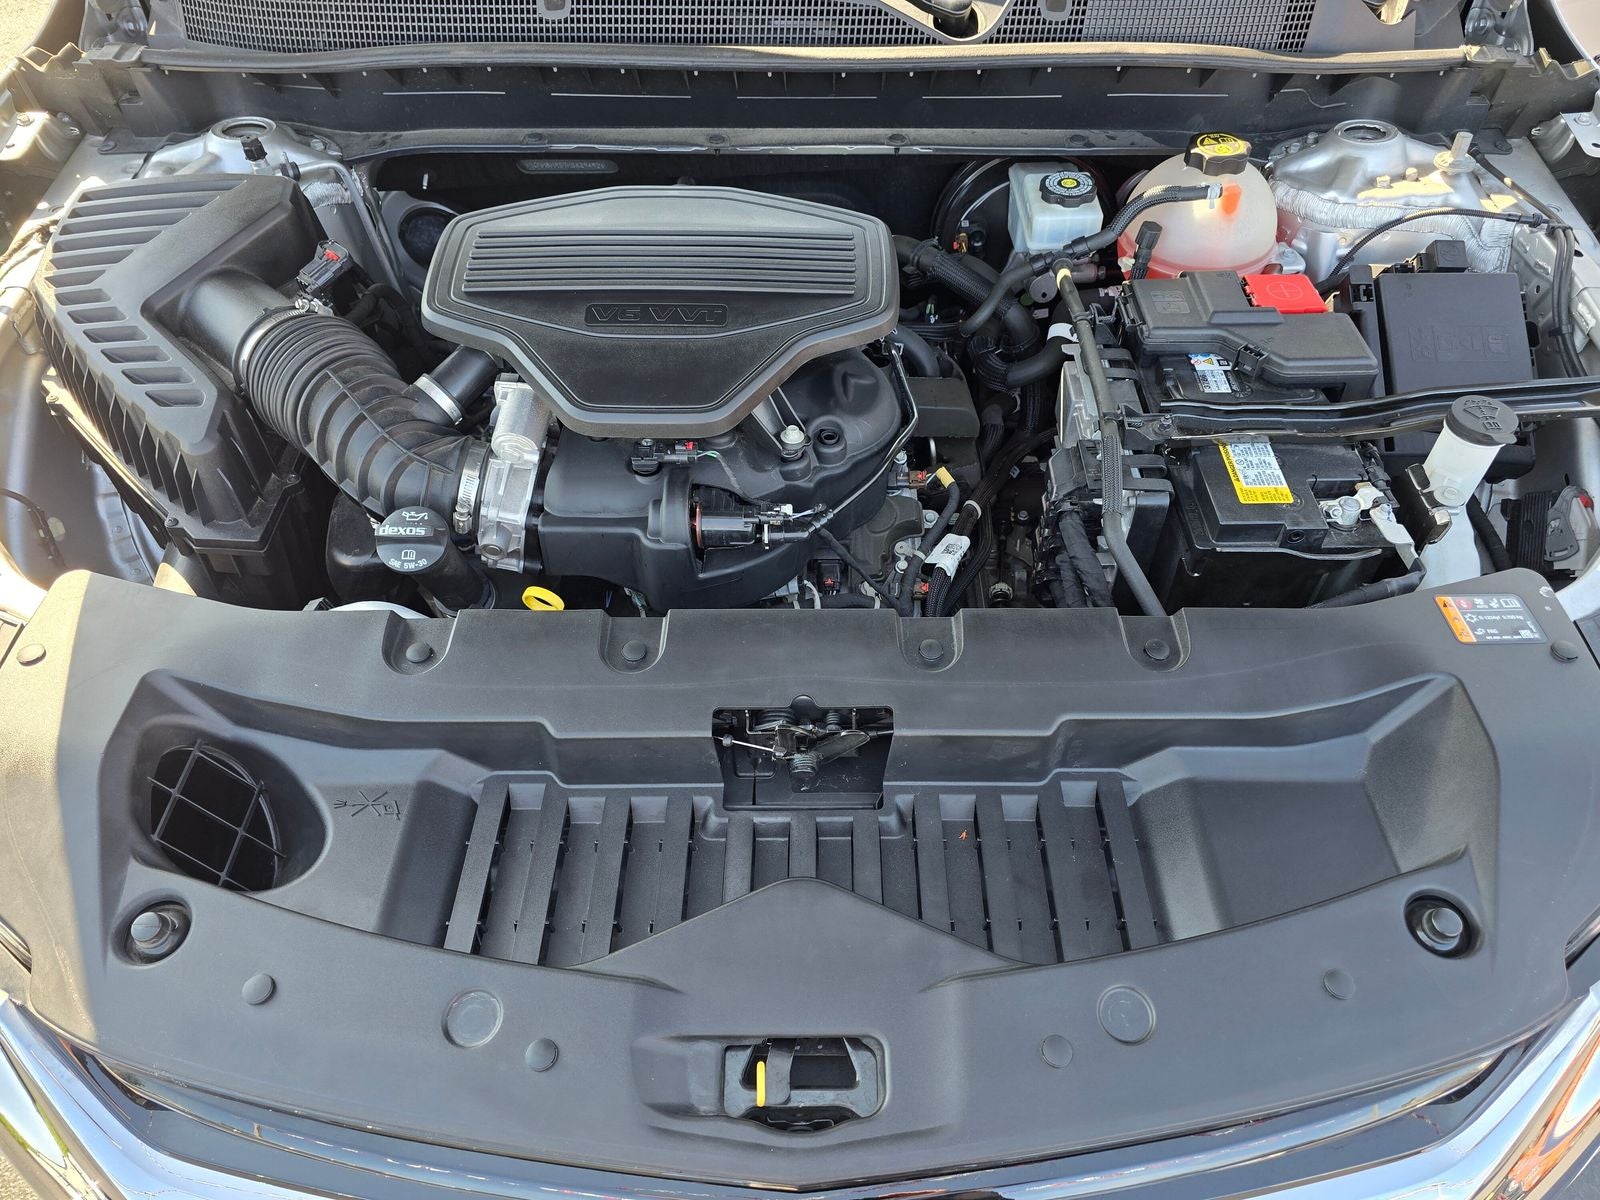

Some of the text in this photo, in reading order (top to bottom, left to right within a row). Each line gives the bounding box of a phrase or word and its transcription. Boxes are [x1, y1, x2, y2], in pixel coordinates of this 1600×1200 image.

[592, 306, 723, 322] V6 VVT
[380, 524, 427, 536] dexos
[388, 559, 428, 569] SAE 5W-30
